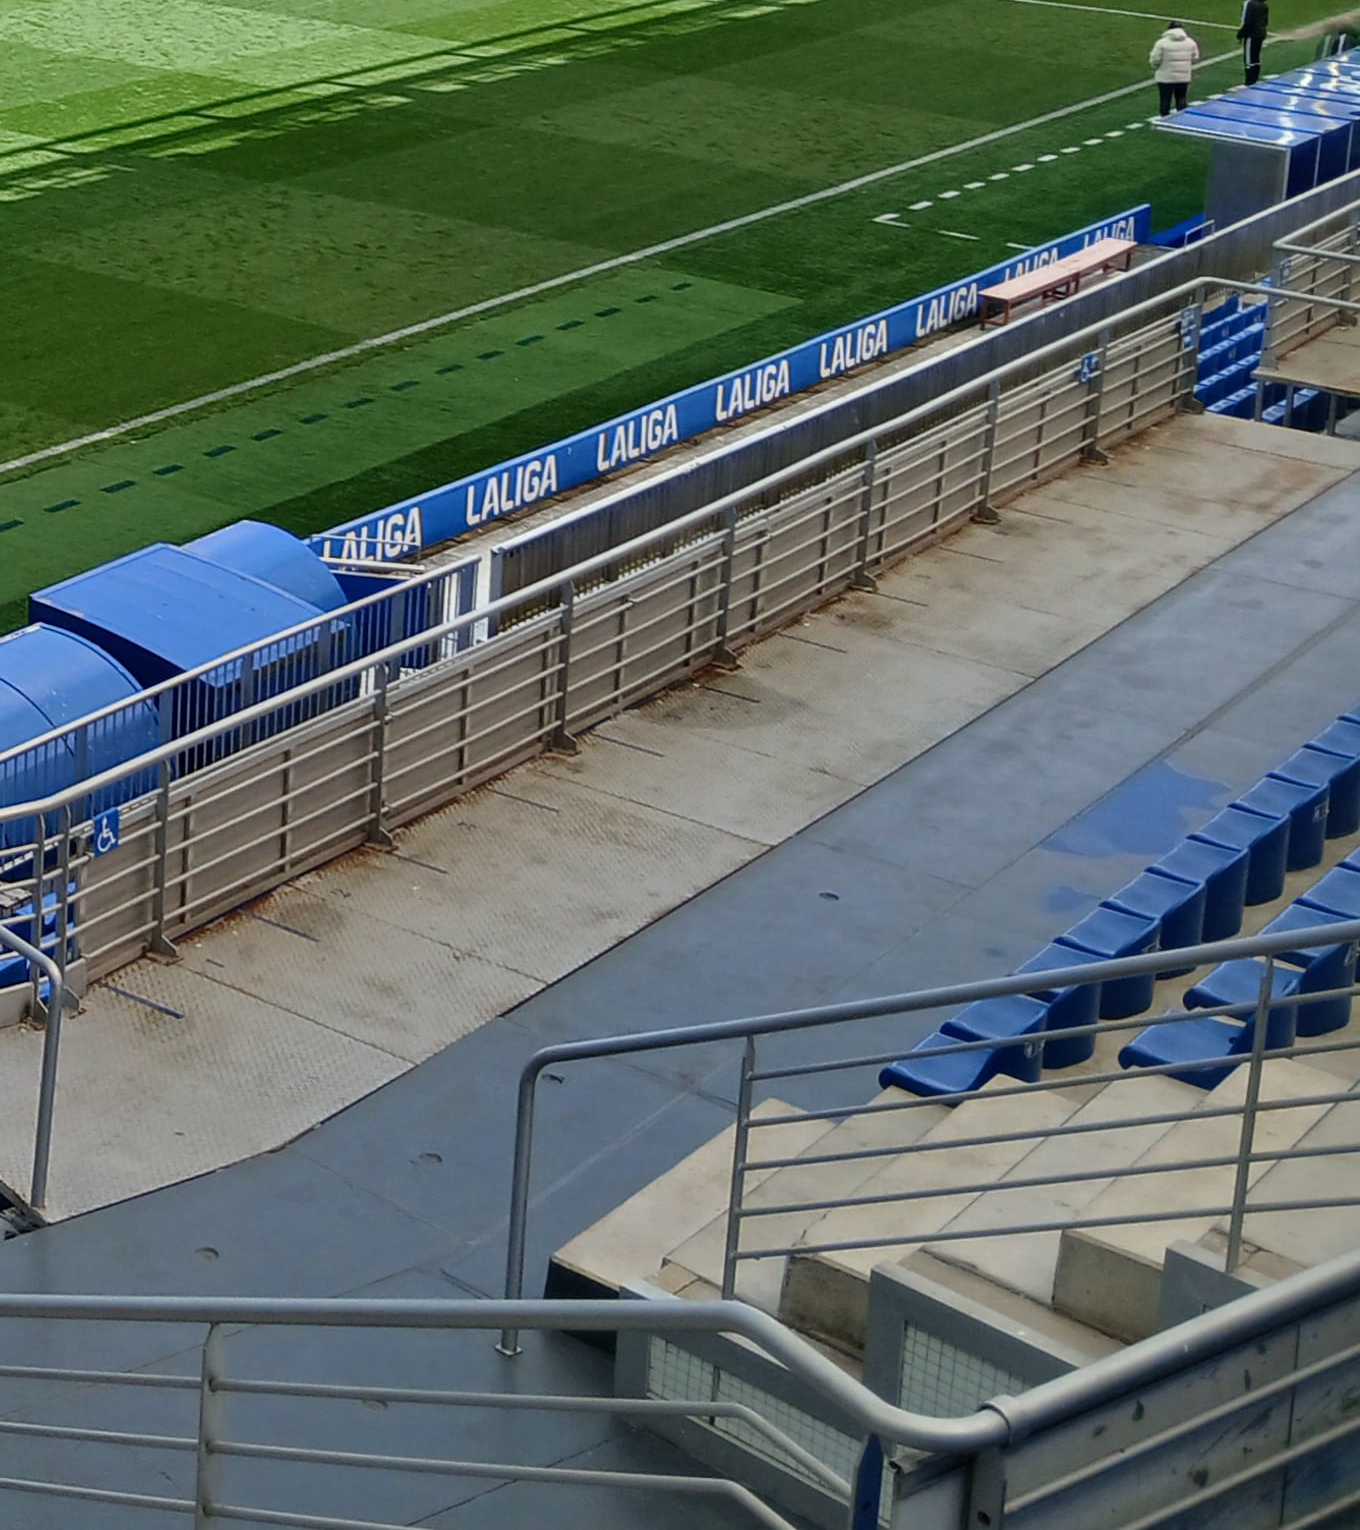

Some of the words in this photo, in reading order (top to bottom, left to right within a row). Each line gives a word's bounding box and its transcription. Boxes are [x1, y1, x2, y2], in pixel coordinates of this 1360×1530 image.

[916, 283, 977, 338] LALIGA
[819, 319, 888, 378] LALIGA
[716, 360, 790, 421] LALIGA
[597, 401, 678, 472] LALIGA
[466, 454, 558, 527] LALIGA
[324, 506, 422, 569] LALIGA
